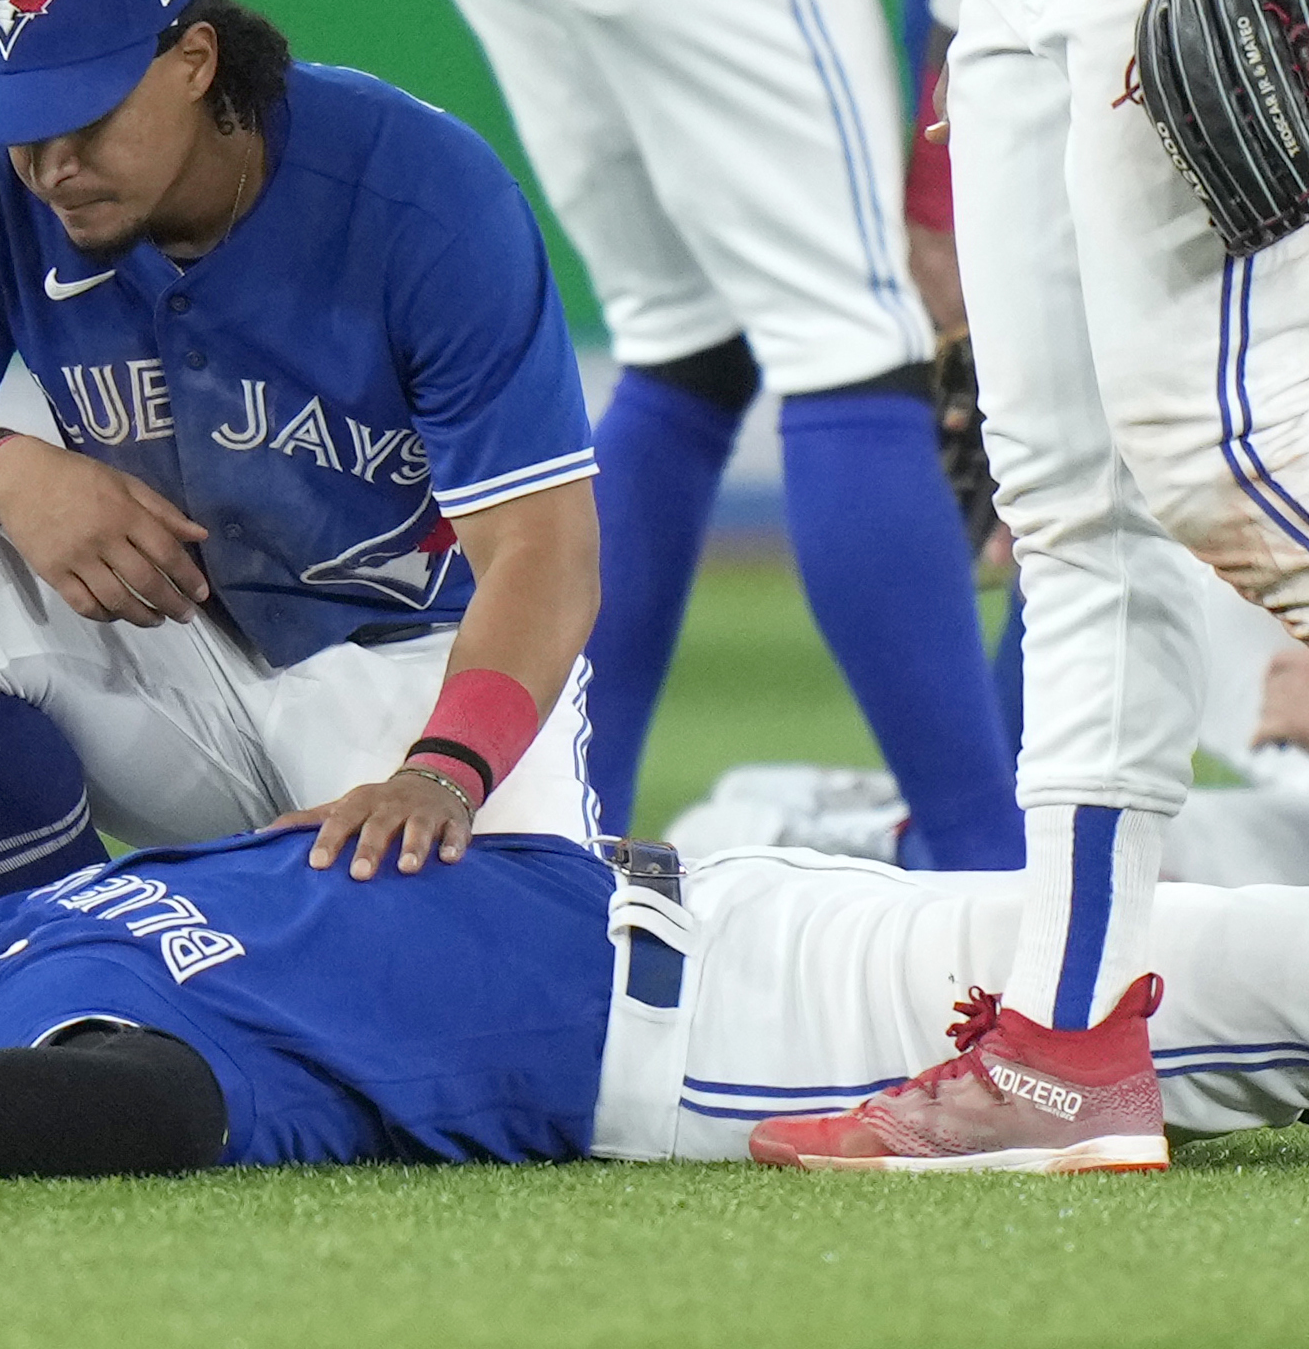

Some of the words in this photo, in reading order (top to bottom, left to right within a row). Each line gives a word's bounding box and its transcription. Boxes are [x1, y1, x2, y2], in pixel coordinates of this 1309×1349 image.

[211, 379, 432, 486] JAYS
[57, 873, 247, 986] BLUE
[989, 1064, 1083, 1115] ADIZERO
